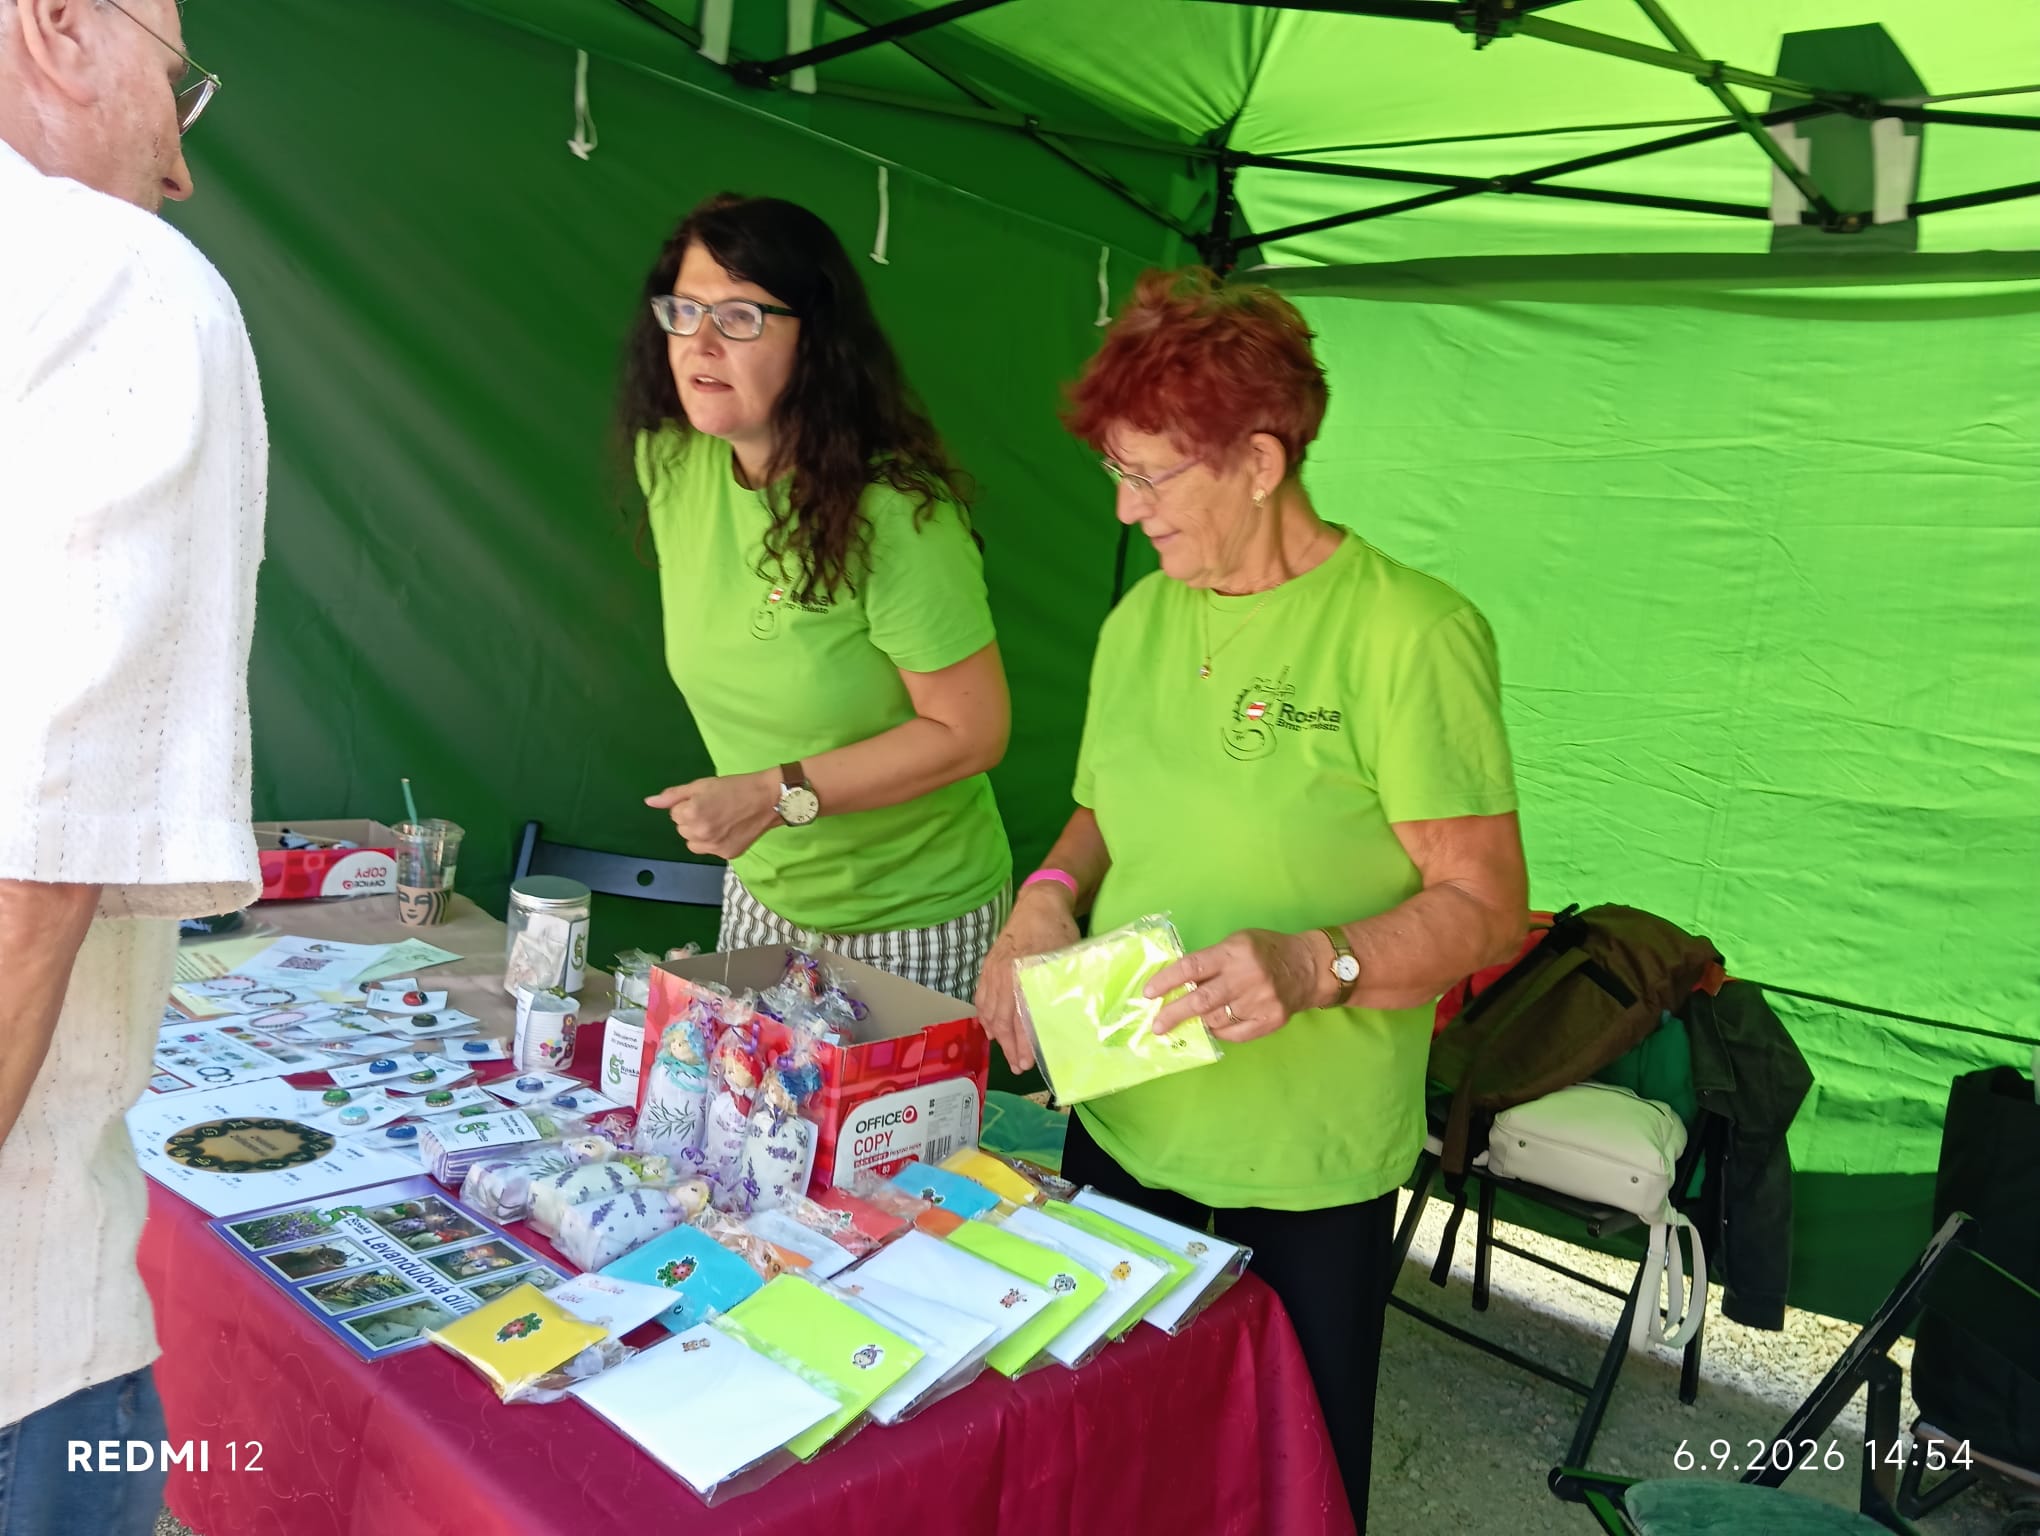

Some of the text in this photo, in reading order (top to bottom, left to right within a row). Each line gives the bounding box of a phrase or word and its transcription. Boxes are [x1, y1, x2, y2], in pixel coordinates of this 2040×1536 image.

[1281, 702, 1340, 722] Roska
[354, 867, 387, 878] COPY
[620, 1065, 640, 1075] Roska
[854, 1130, 893, 1156] COPY
[362, 1235, 477, 1315] Levandulová díln
